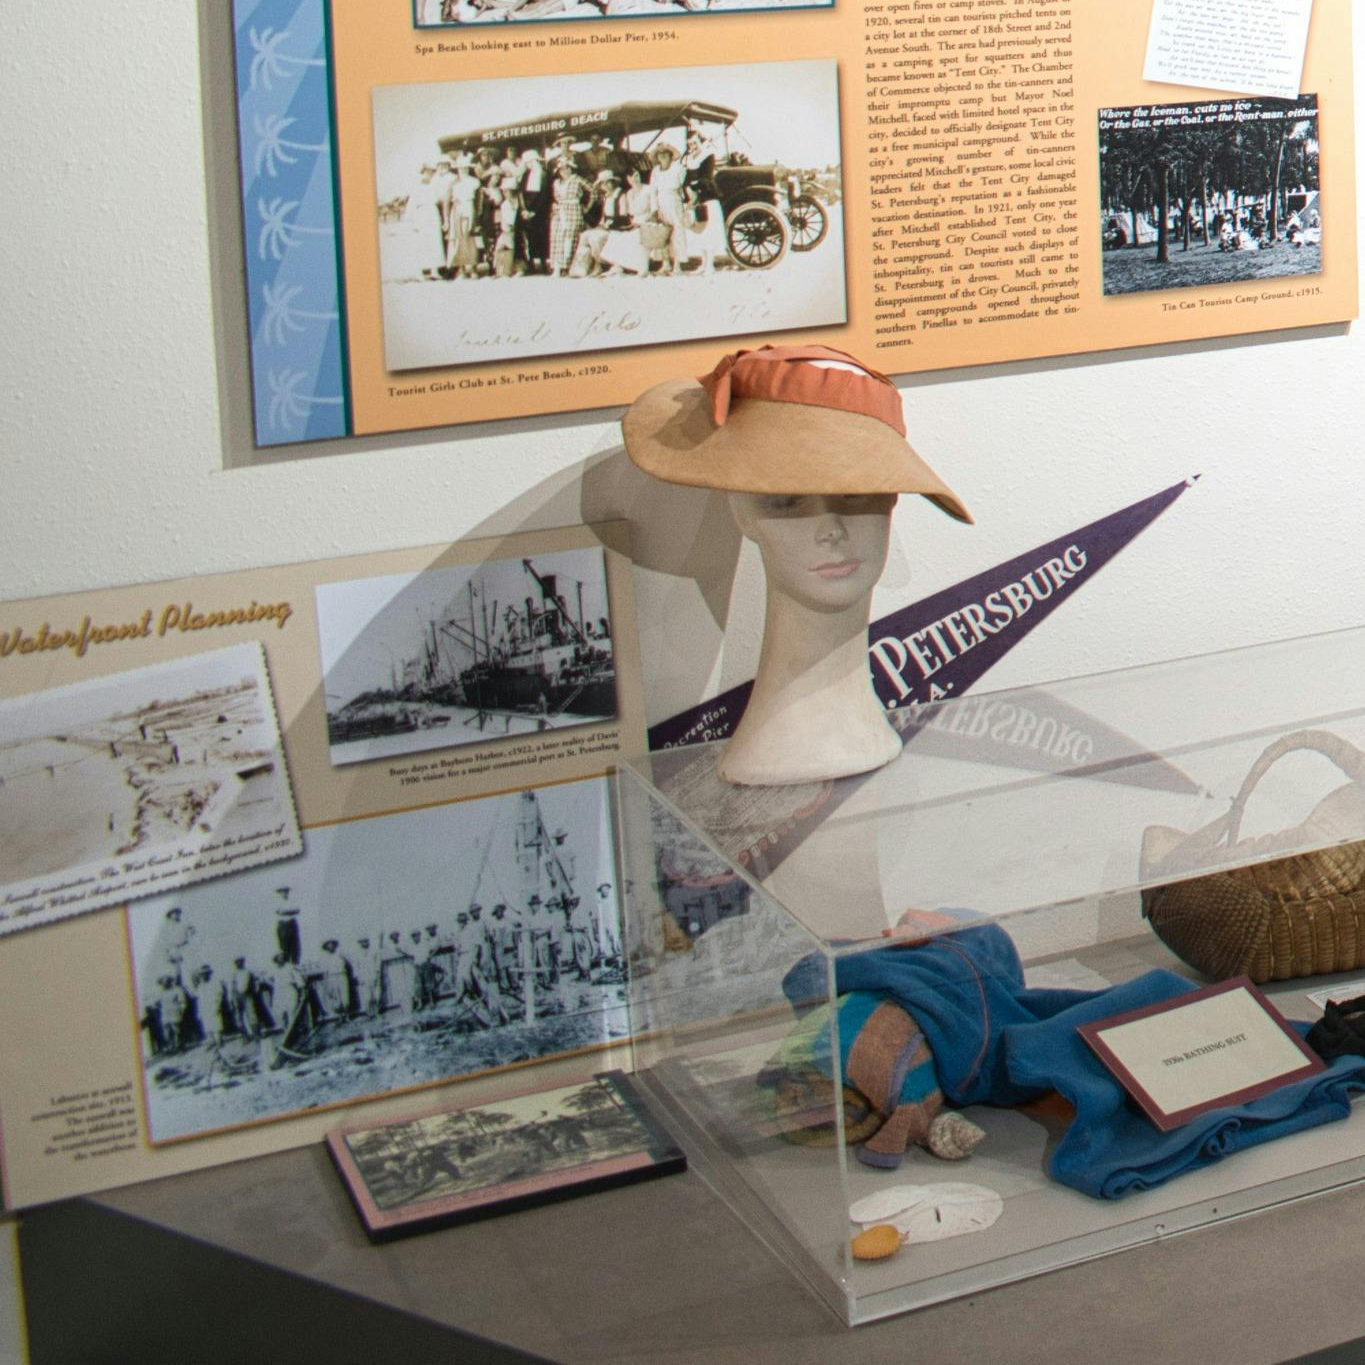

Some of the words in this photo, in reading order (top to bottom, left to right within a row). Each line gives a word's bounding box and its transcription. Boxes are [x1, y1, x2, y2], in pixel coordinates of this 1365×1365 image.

[570, 110, 609, 127] BEACH
[157, 600, 293, 636] Planning
[869, 543, 1089, 696] PETERSBURG
[702, 722, 730, 743] Pier
[1183, 1040, 1226, 1060] BATHING
[1225, 1032, 1247, 1046] SUIT
